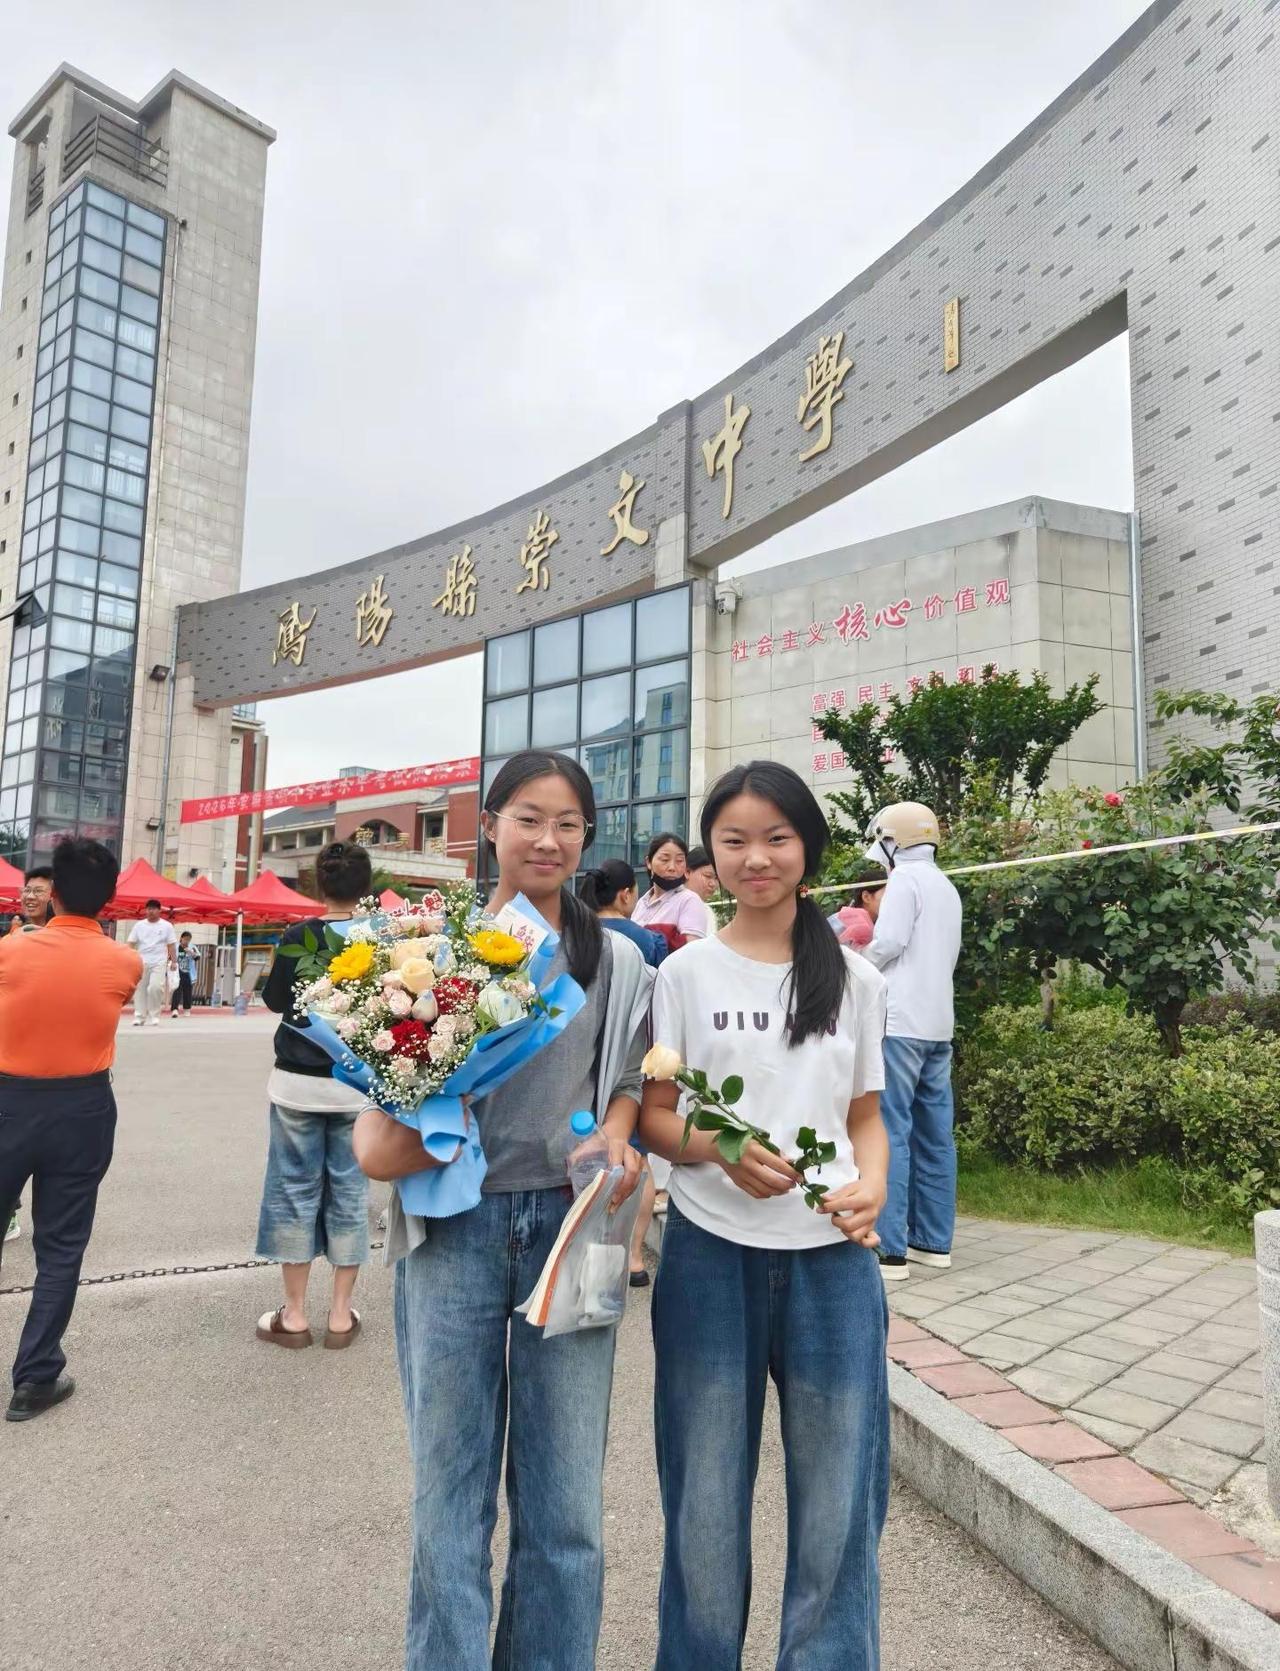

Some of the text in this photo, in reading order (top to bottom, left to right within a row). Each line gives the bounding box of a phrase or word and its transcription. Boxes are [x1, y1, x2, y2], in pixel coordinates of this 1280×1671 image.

[731, 578, 1009, 663] 社会主义核心价值观
[812, 690, 845, 713] 富强
[858, 682, 892, 703] 民主
[812, 752, 845, 773] 爱国
